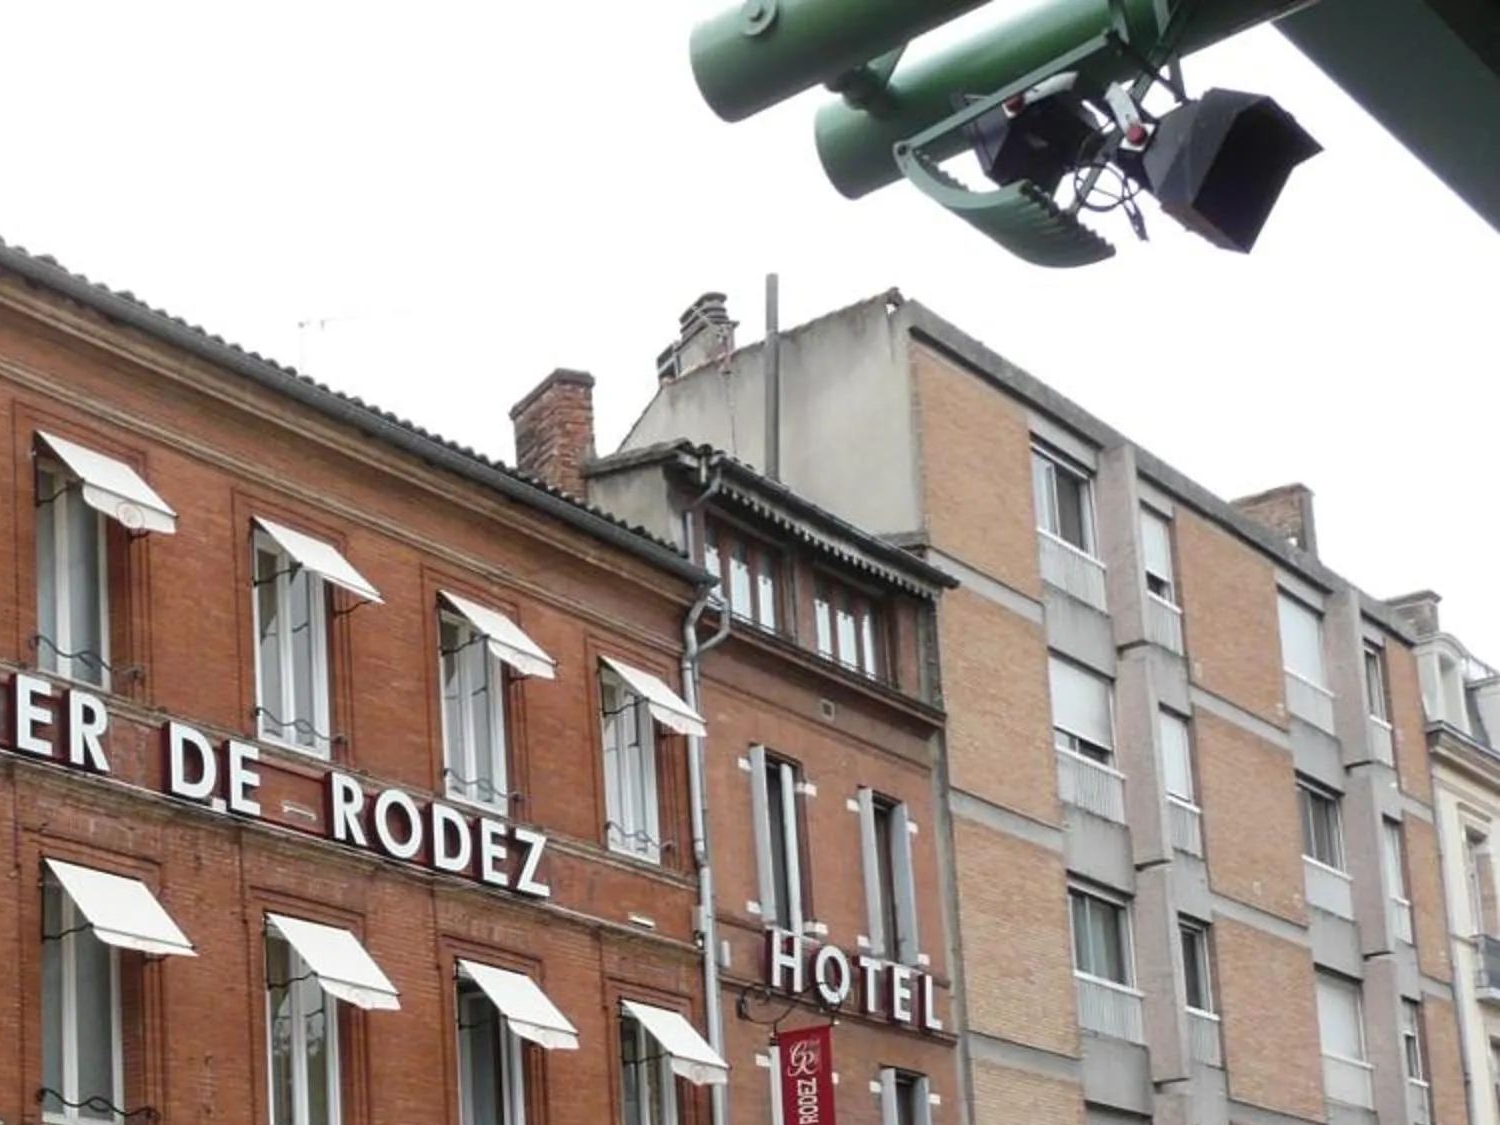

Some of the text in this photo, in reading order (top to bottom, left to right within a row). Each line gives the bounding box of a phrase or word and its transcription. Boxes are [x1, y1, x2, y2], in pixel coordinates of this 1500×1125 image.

[169, 720, 261, 815] DE
[331, 771, 550, 897] RODEZ
[770, 929, 942, 1031] HOTEL
[797, 1077, 819, 1125] RODEZ
